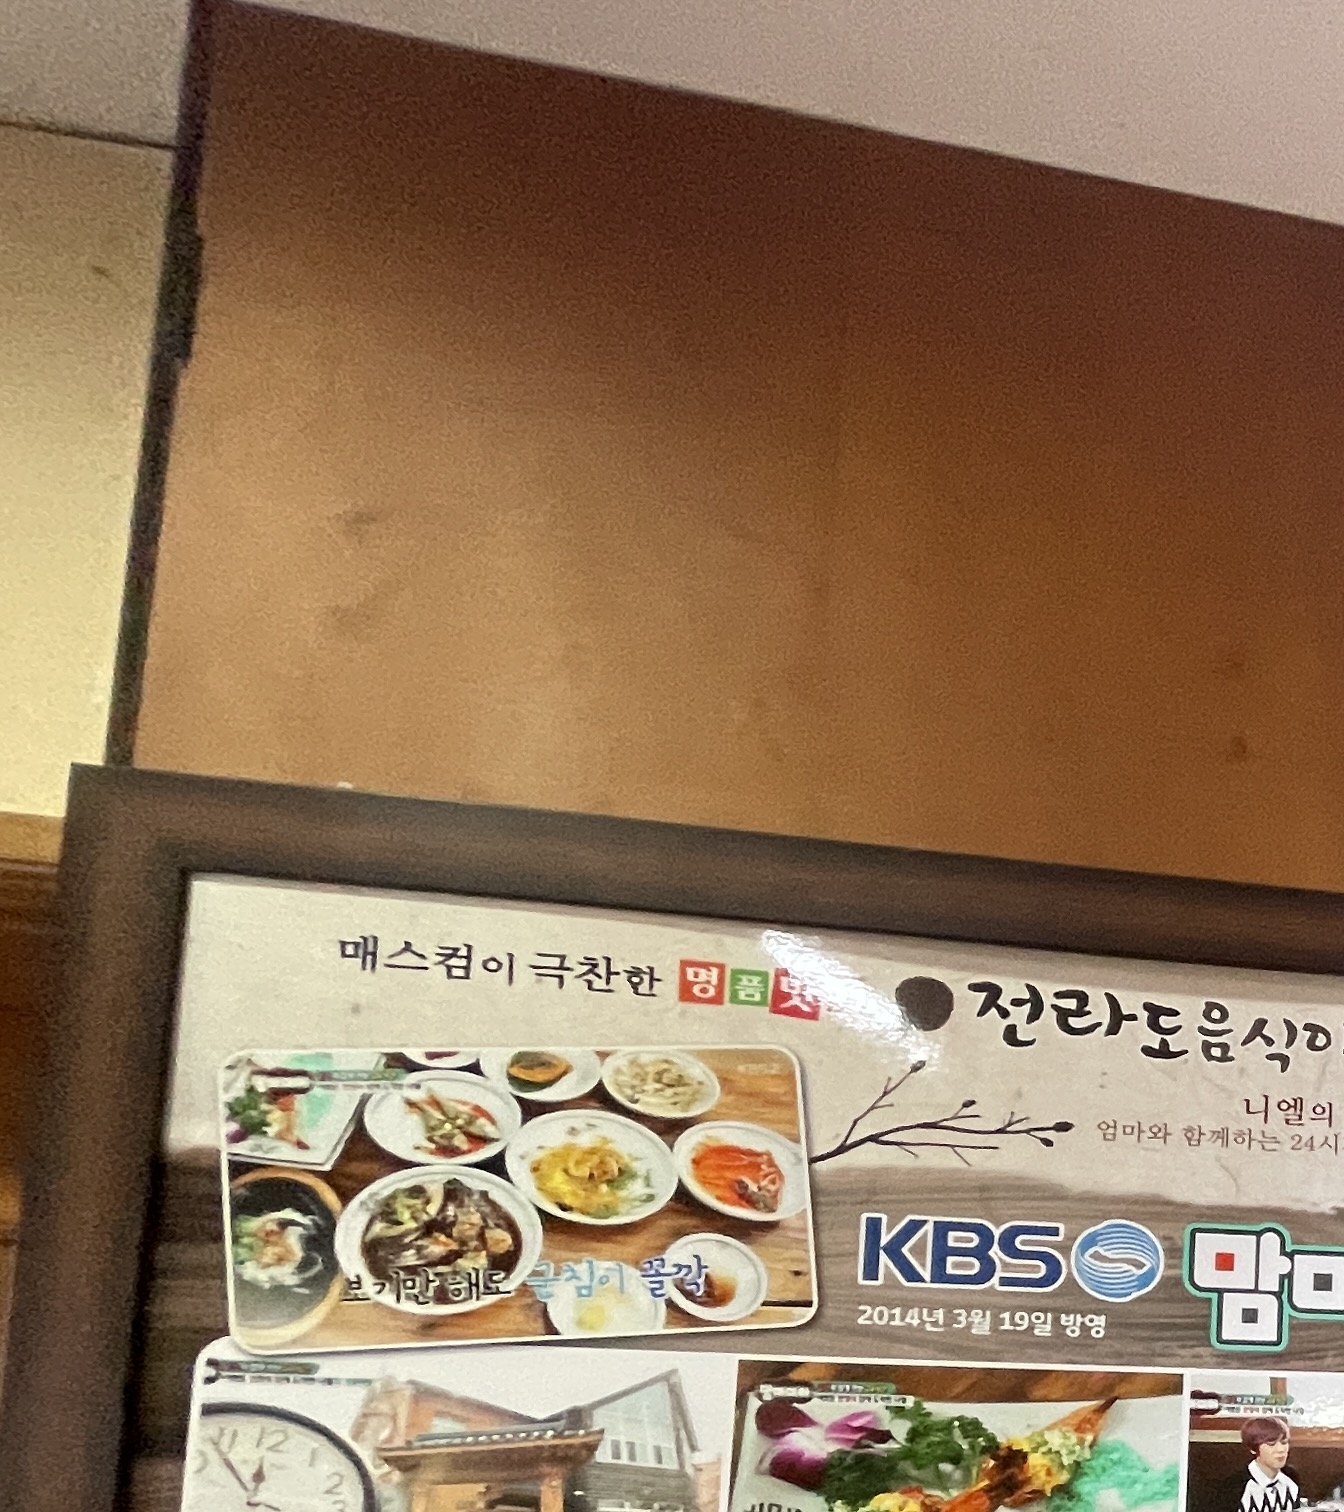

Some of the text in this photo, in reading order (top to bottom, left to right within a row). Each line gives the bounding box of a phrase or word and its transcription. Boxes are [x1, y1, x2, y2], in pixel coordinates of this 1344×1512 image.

[339, 935, 515, 986] 매스컴이
[530, 953, 663, 998] 극찬한
[1243, 1094, 1334, 1128] 니엘의
[1096, 1119, 1172, 1146] 엄마와
[1182, 1123, 1282, 1153] 함께하는
[860, 1217, 1063, 1290] KBS
[857, 1304, 1107, 1341] 2014년 3월 19일 방영
